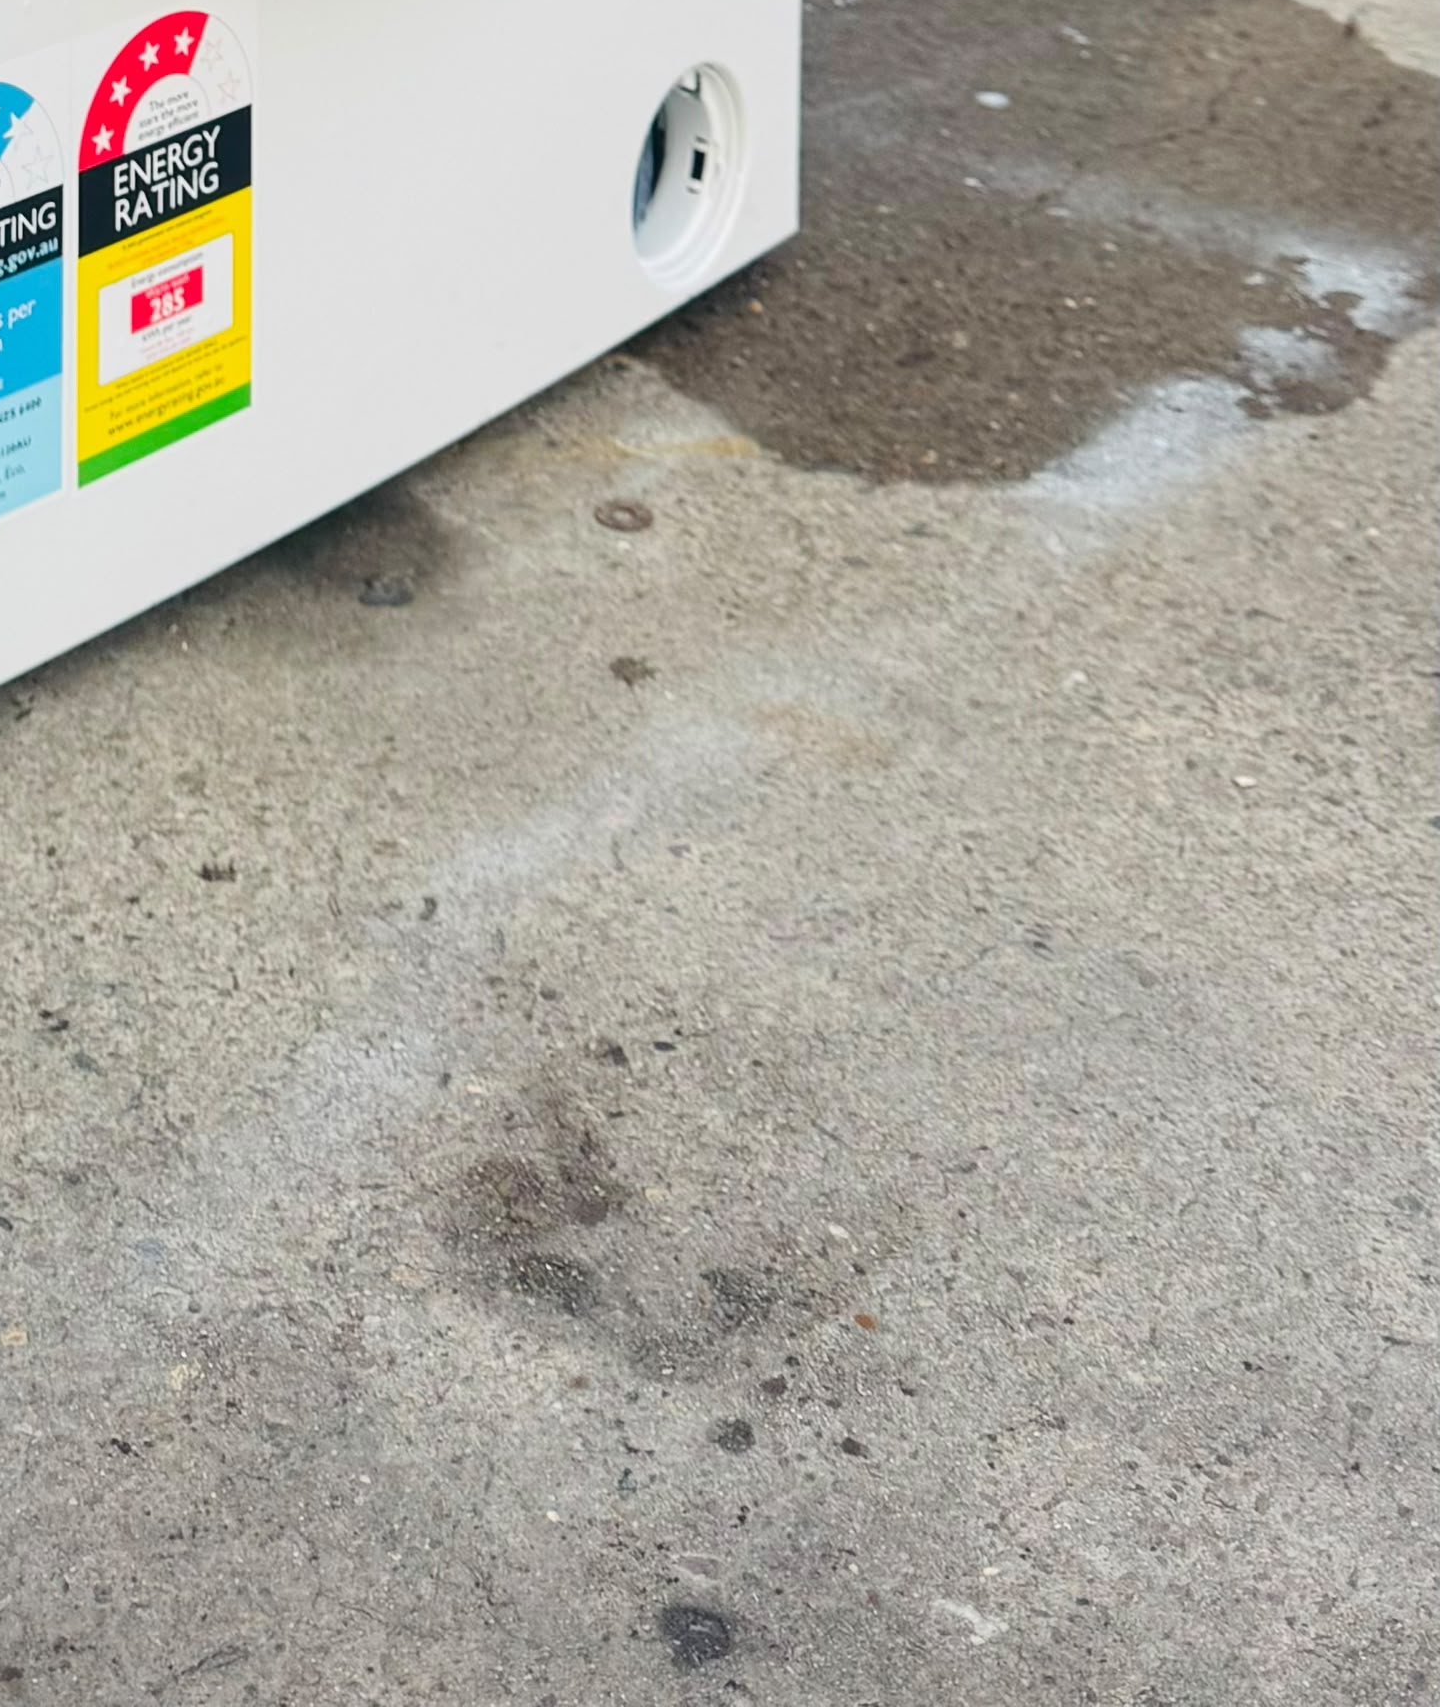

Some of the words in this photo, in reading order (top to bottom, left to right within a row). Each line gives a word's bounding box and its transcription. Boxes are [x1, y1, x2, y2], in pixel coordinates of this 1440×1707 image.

[113, 125, 221, 197] ENERGY
[115, 161, 219, 233] RATING
[7, 299, 37, 330] per
[149, 285, 186, 324] 285
